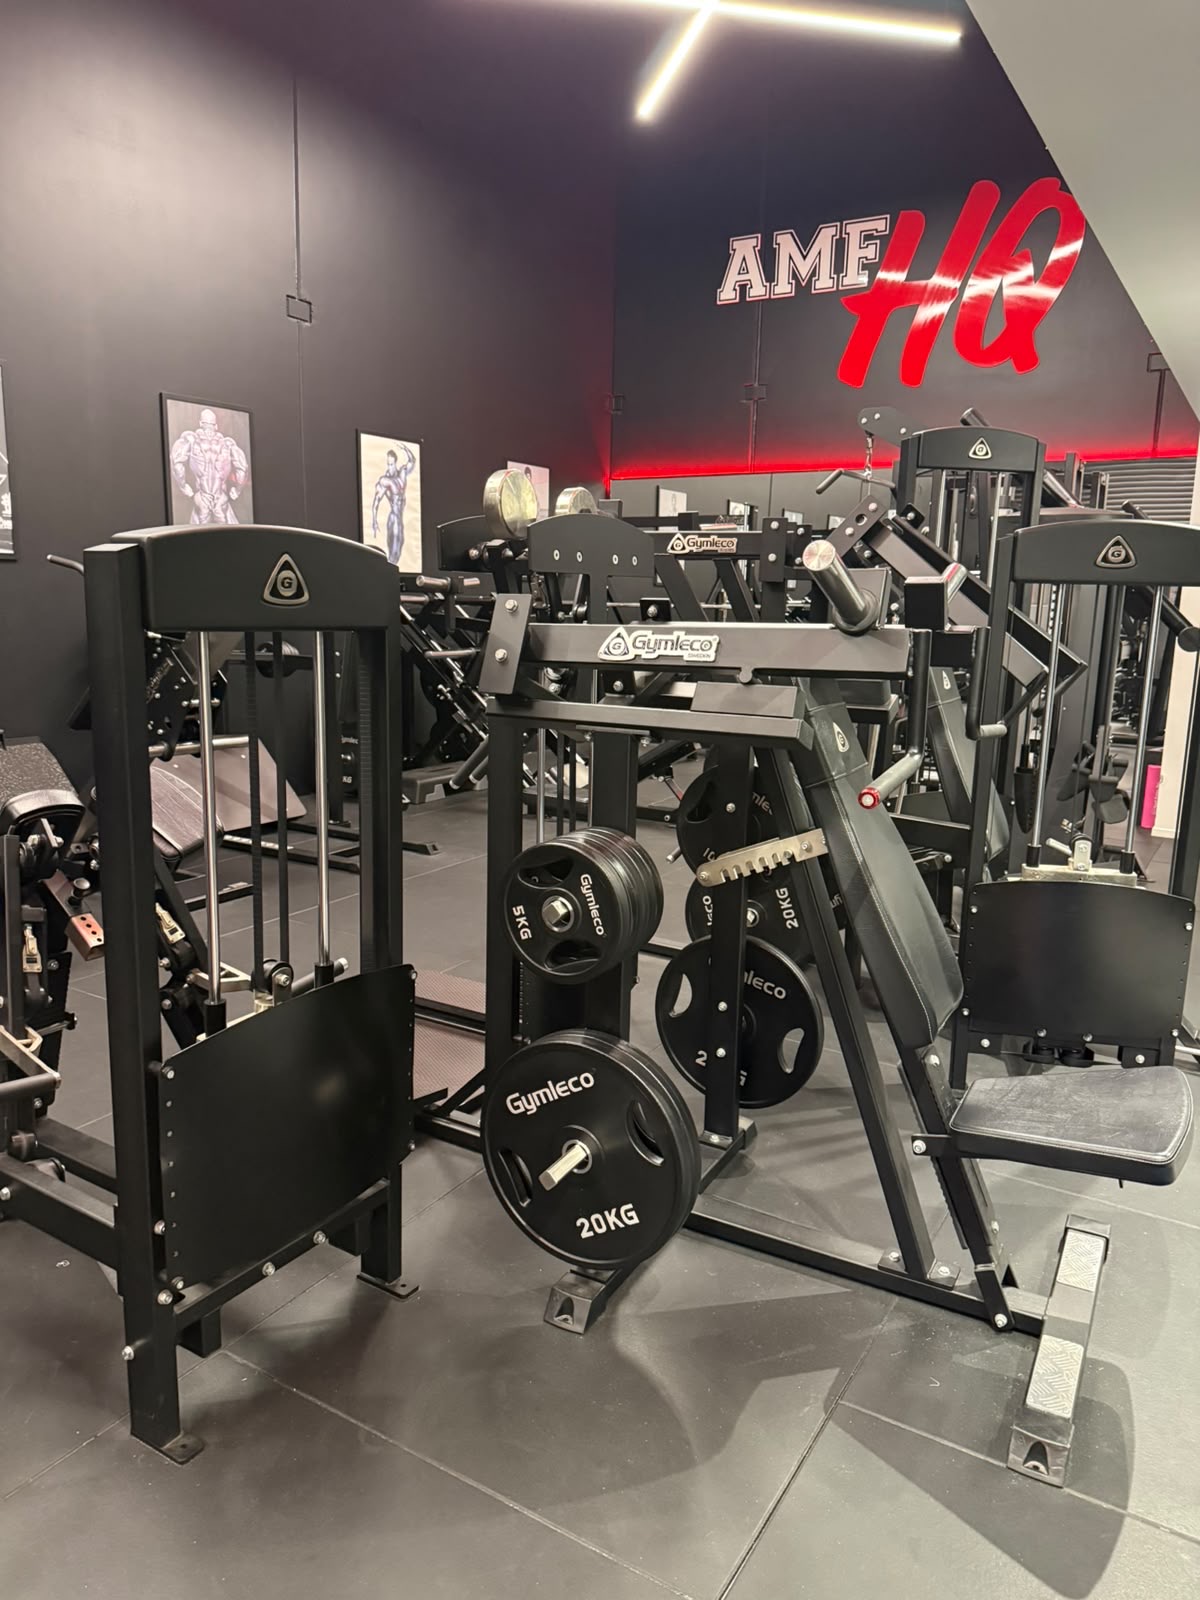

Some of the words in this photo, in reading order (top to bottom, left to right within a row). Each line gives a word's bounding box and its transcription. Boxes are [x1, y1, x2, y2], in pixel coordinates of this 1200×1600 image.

[716, 213, 890, 305] AMF
[838, 177, 1086, 388] HQ
[686, 537, 735, 550] Gymleco
[632, 634, 713, 654] Gymleco
[512, 904, 533, 941] 5KG
[580, 873, 605, 936] Gymleco
[775, 887, 799, 930] 20KG
[505, 1072, 595, 1115] Gymleco
[575, 1202, 640, 1239] 20KG
